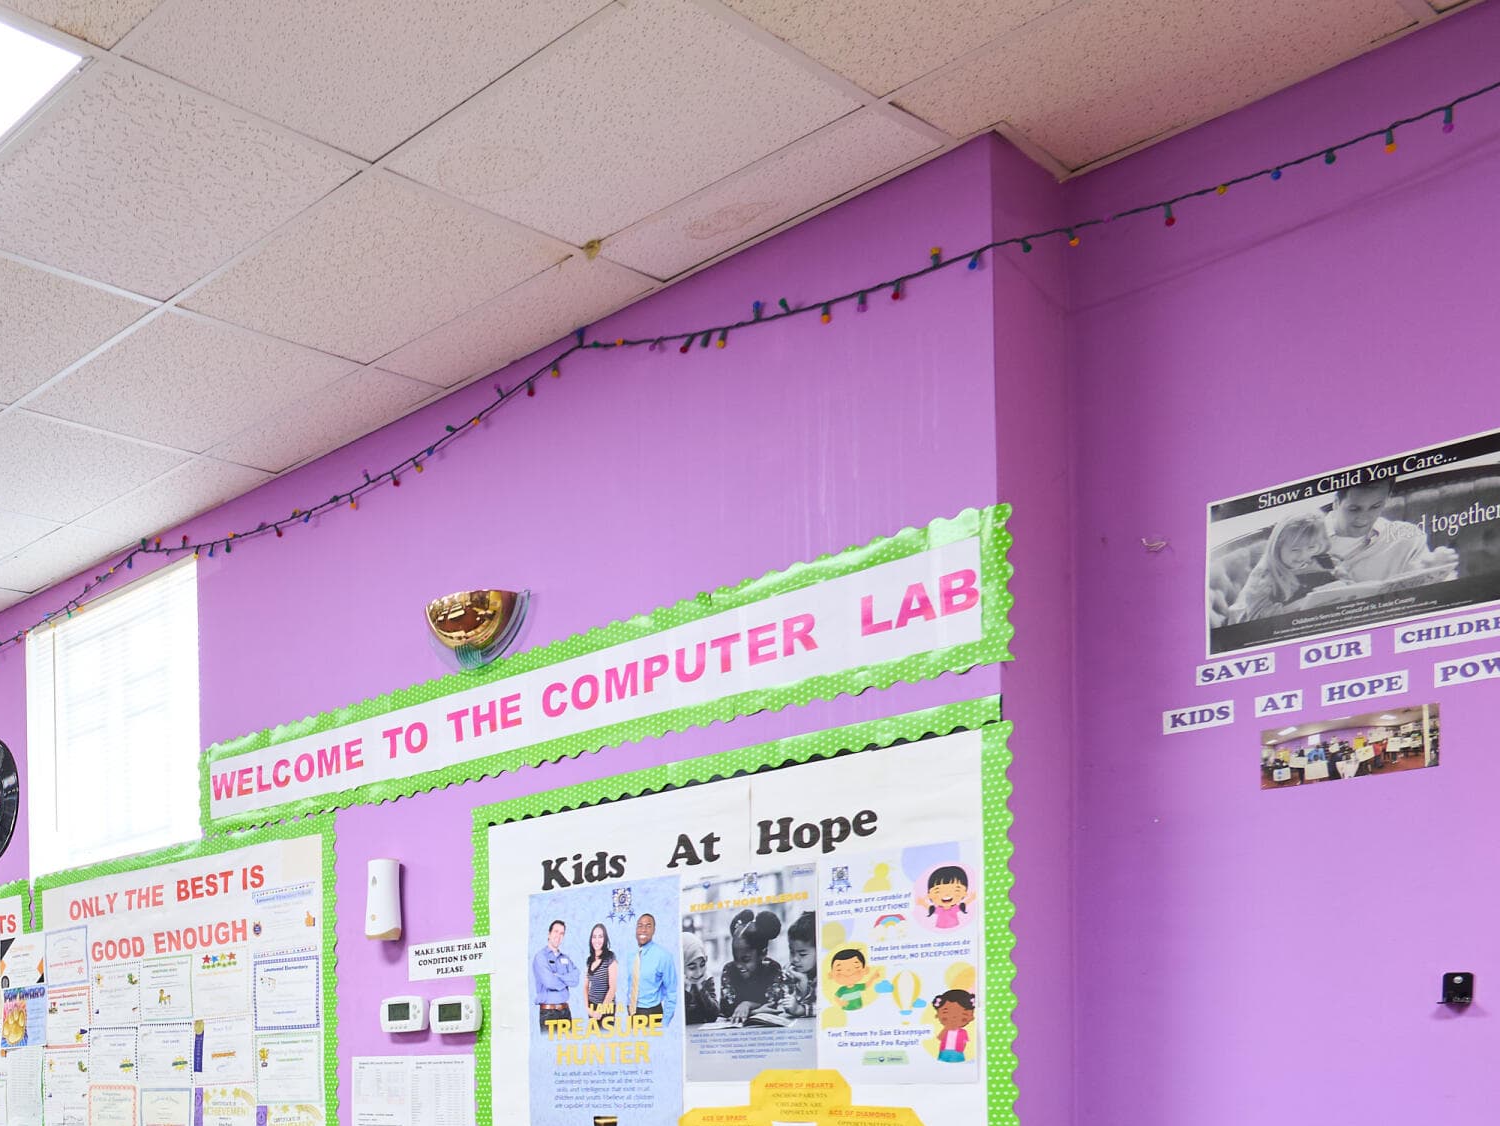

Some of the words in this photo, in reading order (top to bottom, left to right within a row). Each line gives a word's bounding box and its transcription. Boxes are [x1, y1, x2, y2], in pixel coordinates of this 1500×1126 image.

[1258, 490, 1300, 510] Show
[1304, 486, 1312, 497] a
[1317, 470, 1360, 493] Child
[1367, 465, 1398, 481] You
[1403, 453, 1457, 472] Care...
[1201, 657, 1269, 683] SAVE
[1304, 641, 1363, 663] OUR
[212, 739, 363, 800] WELCOME
[382, 722, 428, 759] TO
[447, 693, 522, 743] THE
[542, 613, 818, 717] COMPUTER
[860, 568, 980, 637] LAB
[1170, 706, 1230, 729] KIDS
[1261, 694, 1298, 712] AT
[1328, 676, 1402, 701] HOPE
[542, 852, 626, 891] Kids
[667, 832, 721, 868] At
[757, 809, 877, 855] Hope
[69, 893, 118, 920] ONLY
[125, 885, 164, 911] THE
[176, 871, 233, 902] BEST
[242, 864, 264, 890] IS
[690, 902, 714, 912] KIDS
[717, 901, 730, 909] AT
[733, 896, 763, 907] HOPE
[765, 891, 808, 904] PLEDGE
[876, 894, 902, 903] capable
[865, 902, 910, 912] EXCEPTIONS!
[92, 936, 145, 962] GOOD
[154, 918, 247, 954] ENOUGH
[414, 947, 435, 957] MAKE
[436, 945, 456, 954] SURE
[457, 943, 472, 952] THE
[473, 941, 487, 949] AIR
[933, 940, 960, 948] capaces
[418, 956, 458, 967] CONDITION
[460, 954, 467, 962] IS
[469, 953, 483, 961] OFF
[436, 965, 464, 975] PLEASE
[595, 1003, 614, 1015] AM
[616, 1002, 624, 1013] A
[544, 1013, 663, 1041] TREASURE
[556, 1041, 650, 1066] HUNTER
